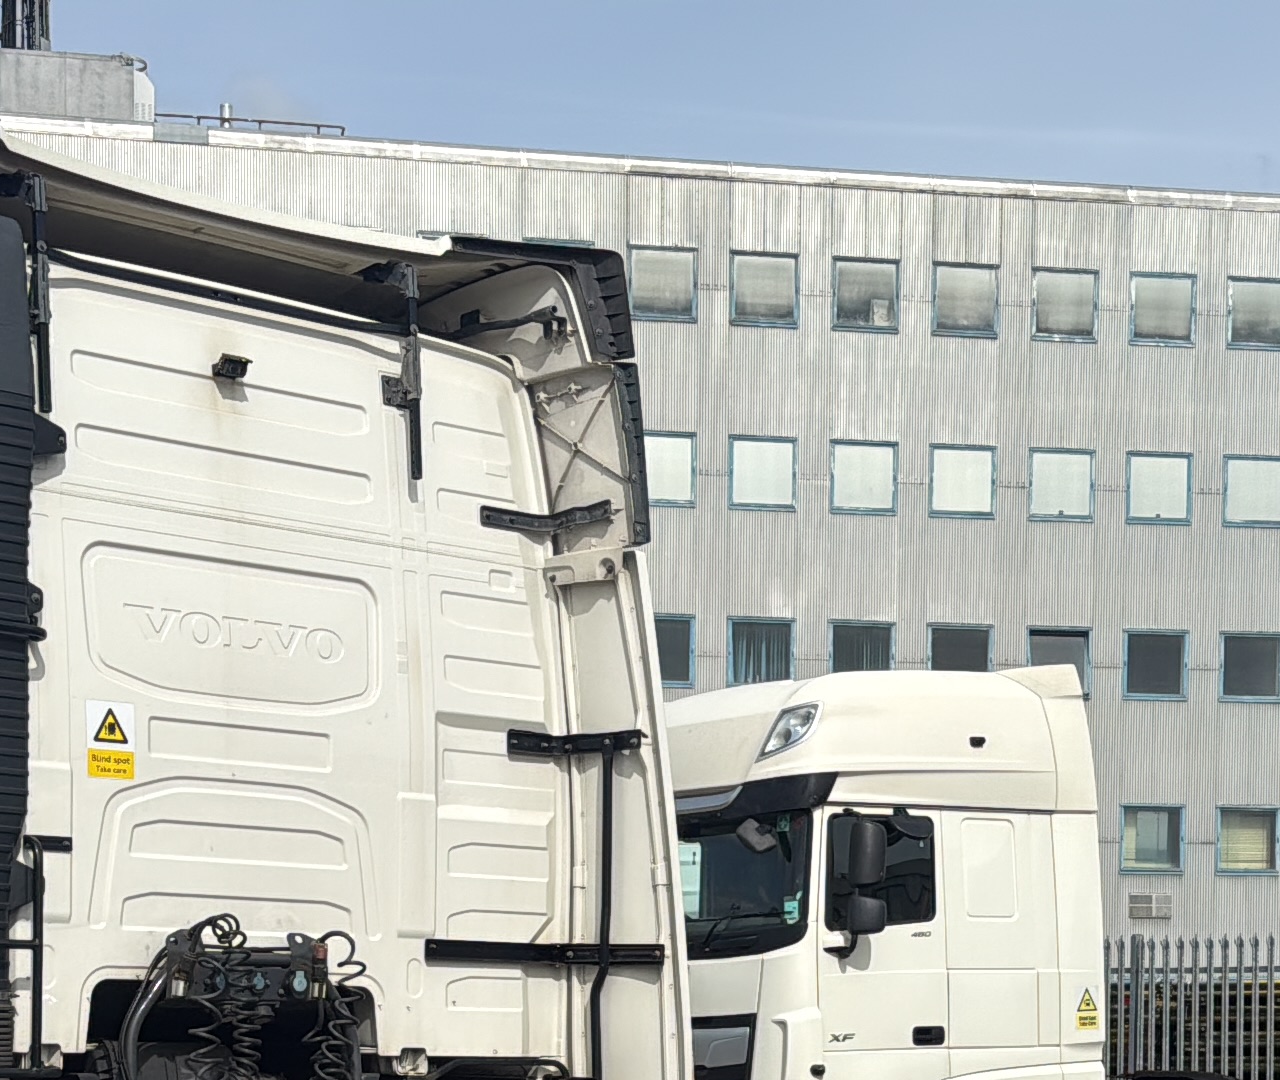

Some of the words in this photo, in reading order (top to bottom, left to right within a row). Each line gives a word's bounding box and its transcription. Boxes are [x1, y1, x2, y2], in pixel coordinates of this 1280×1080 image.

[122, 602, 345, 664] VOLVO
[91, 753, 111, 763] Blind
[113, 757, 130, 765] spot
[96, 765, 111, 773] Take
[828, 1033, 856, 1043] XF
